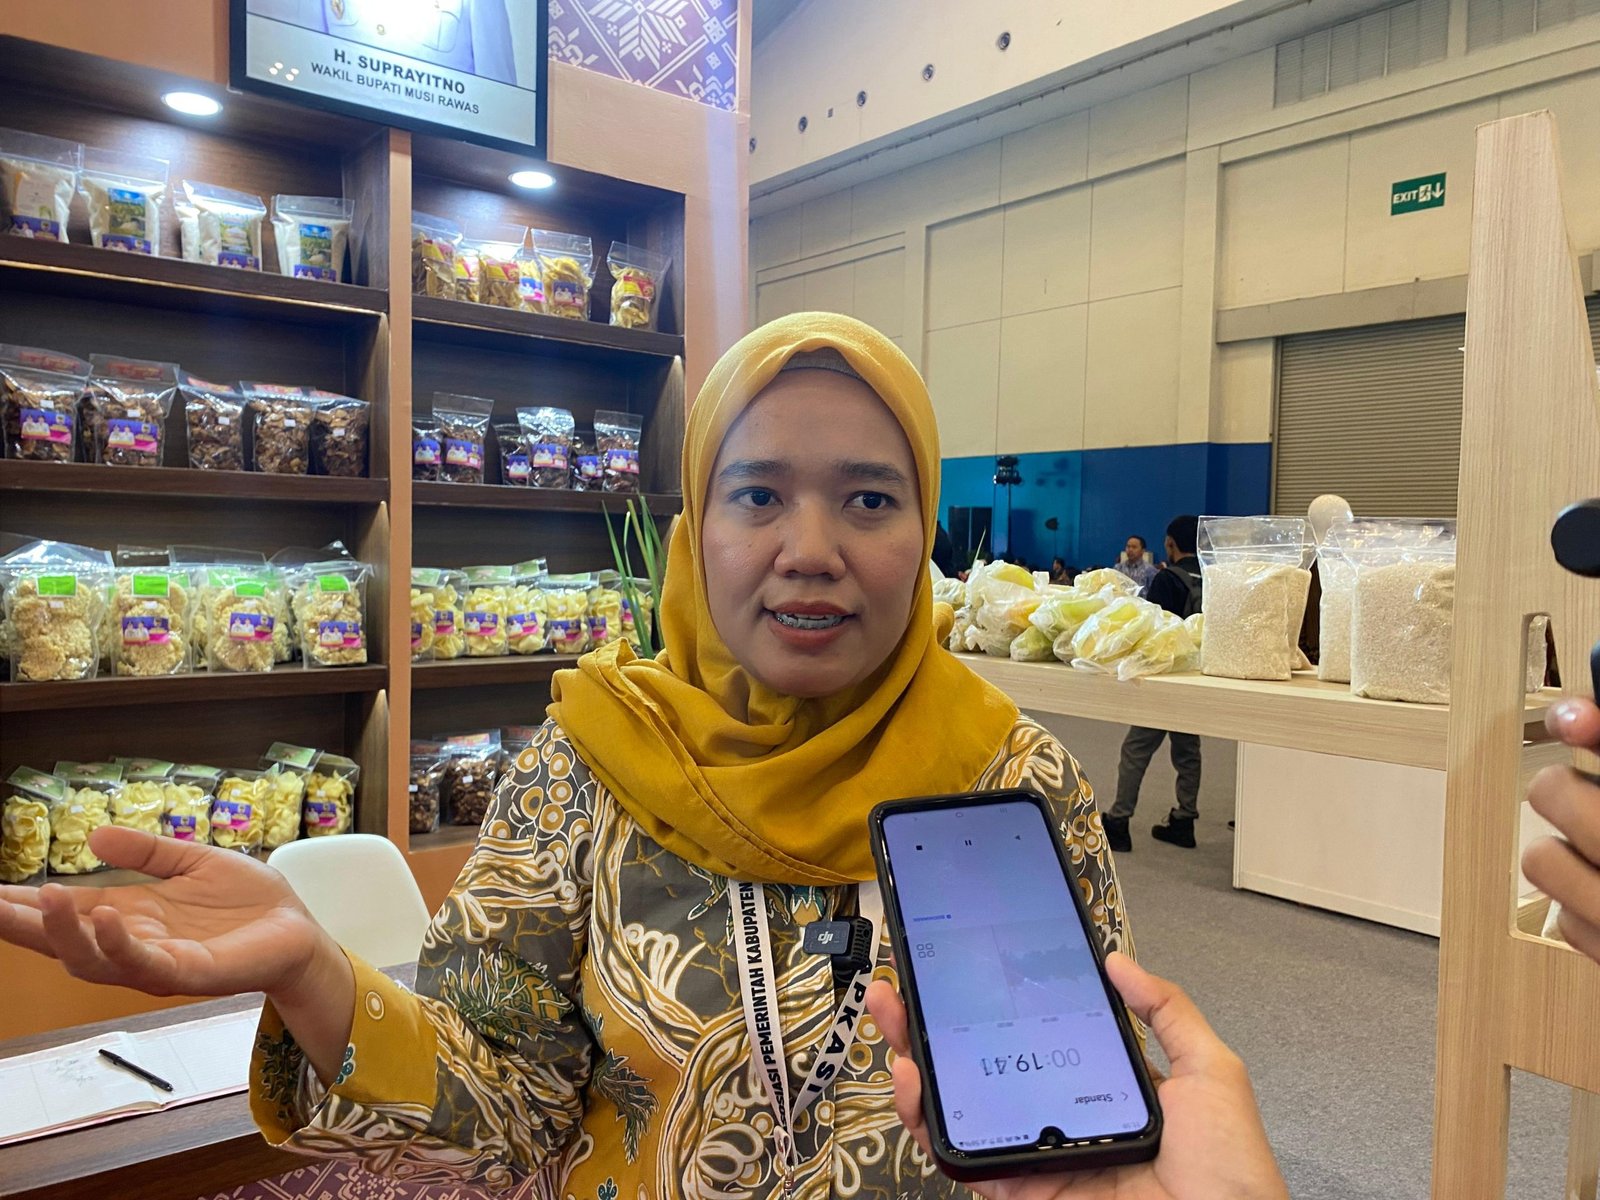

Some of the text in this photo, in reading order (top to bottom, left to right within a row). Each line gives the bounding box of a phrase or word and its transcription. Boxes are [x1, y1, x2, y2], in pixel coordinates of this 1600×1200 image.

[311, 62, 480, 115] WAKIL BUPATI MUSI RAWAS
[334, 48, 465, 94] H. SUPRAYITNO
[1393, 190, 1418, 204] EXIT
[739, 882, 763, 964] KABUPATEN
[749, 967, 776, 1065] PEMERINTAH
[1074, 1093, 1113, 1105] Standar
